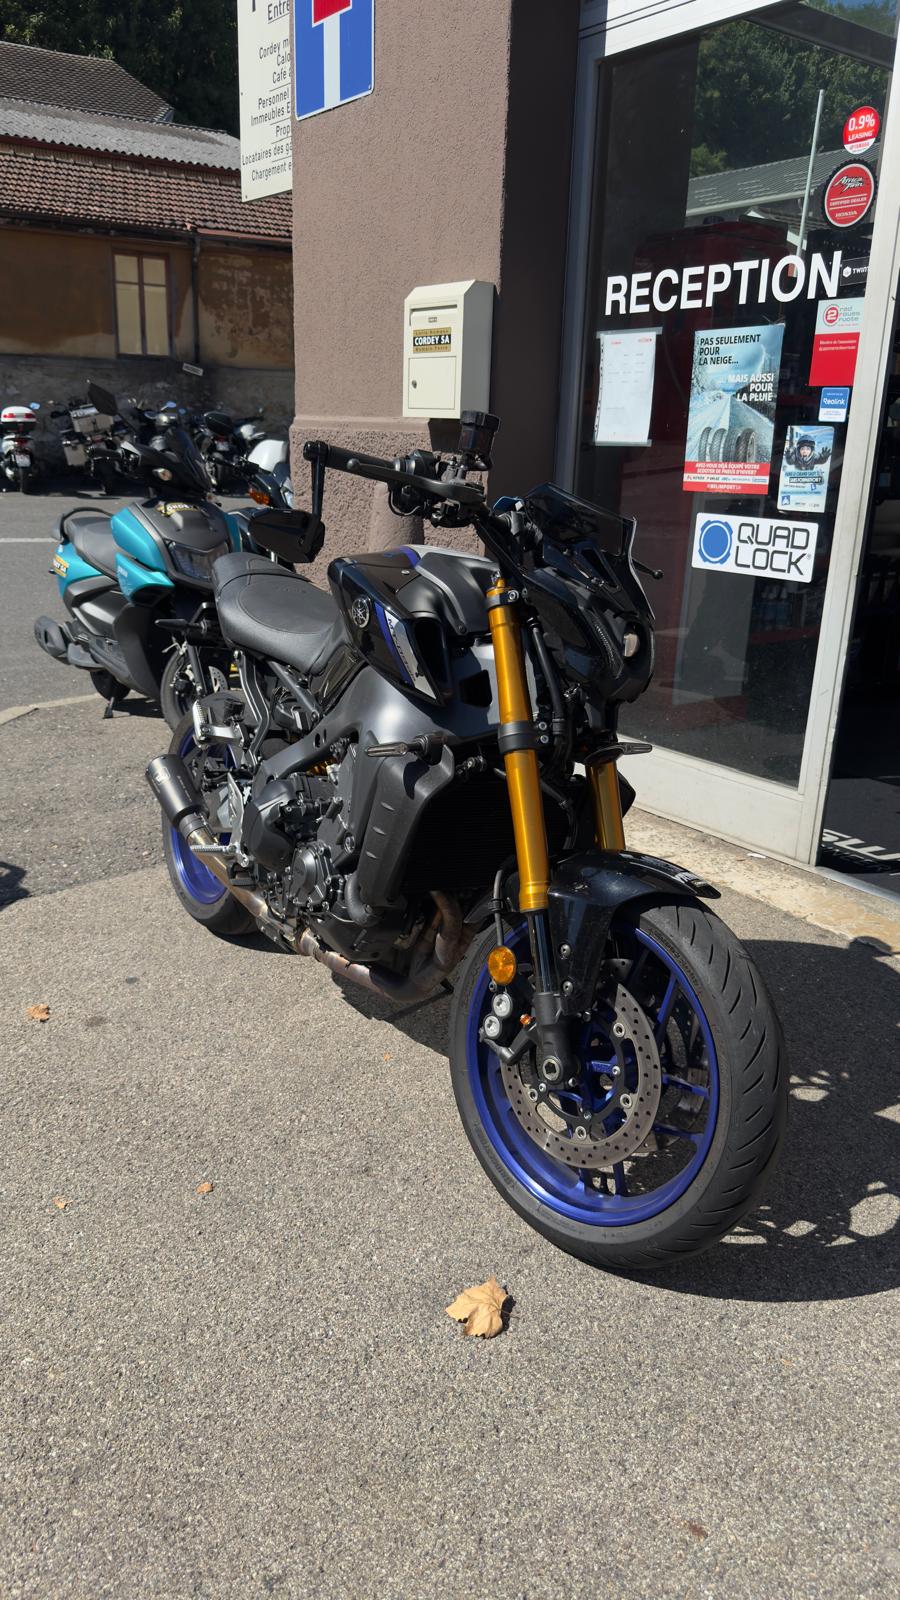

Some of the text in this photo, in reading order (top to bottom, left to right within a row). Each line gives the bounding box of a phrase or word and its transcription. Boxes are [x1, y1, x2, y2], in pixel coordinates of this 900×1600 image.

[259, 42, 281, 59] Cordey
[273, 67, 287, 84] Café
[258, 87, 290, 110] Personnel
[250, 105, 285, 127] Immeubles
[848, 112, 876, 132] 0.9%
[848, 130, 873, 142] LEASING
[242, 148, 272, 166] Locataires
[273, 144, 284, 156] des
[251, 161, 287, 181] Chargement
[604, 250, 842, 316] RECEPTION
[415, 335, 450, 345] CORDEY SA
[700, 334, 761, 346] PAS SEULEMENT
[699, 346, 720, 356] POUR
[698, 356, 739, 366] LA NEIGE...
[728, 373, 775, 383] MAIS AUSSI
[750, 382, 774, 392] POUR
[736, 392, 773, 402] LA PLUIE
[738, 522, 810, 550] QUAD
[735, 546, 807, 576] LOCK
